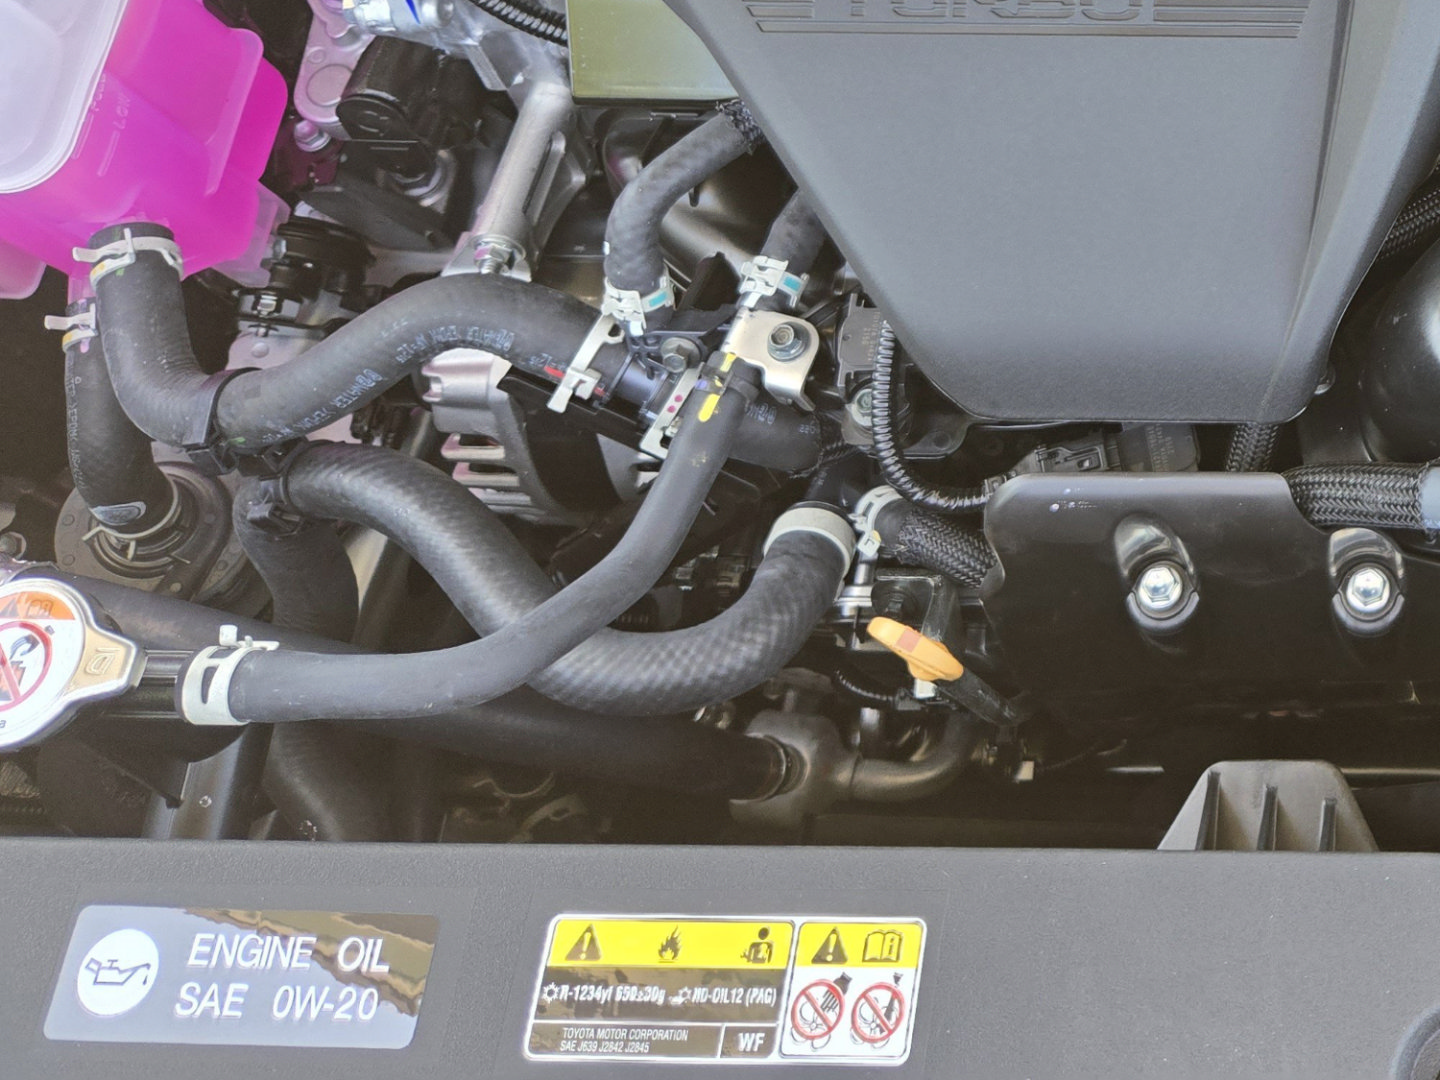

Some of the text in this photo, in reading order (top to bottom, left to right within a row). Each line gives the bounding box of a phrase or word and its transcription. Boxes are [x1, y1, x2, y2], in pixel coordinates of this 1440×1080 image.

[187, 932, 391, 973] ENGINE OIL
[174, 981, 379, 1021] SAE 0W-20
[745, 987, 777, 1007] (PAG)
[563, 1027, 688, 1041] TOYOTA MOTOR CORPORATION
[737, 1032, 765, 1052] WF
[560, 1040, 650, 1053] SAE J639 J2842 J2845
